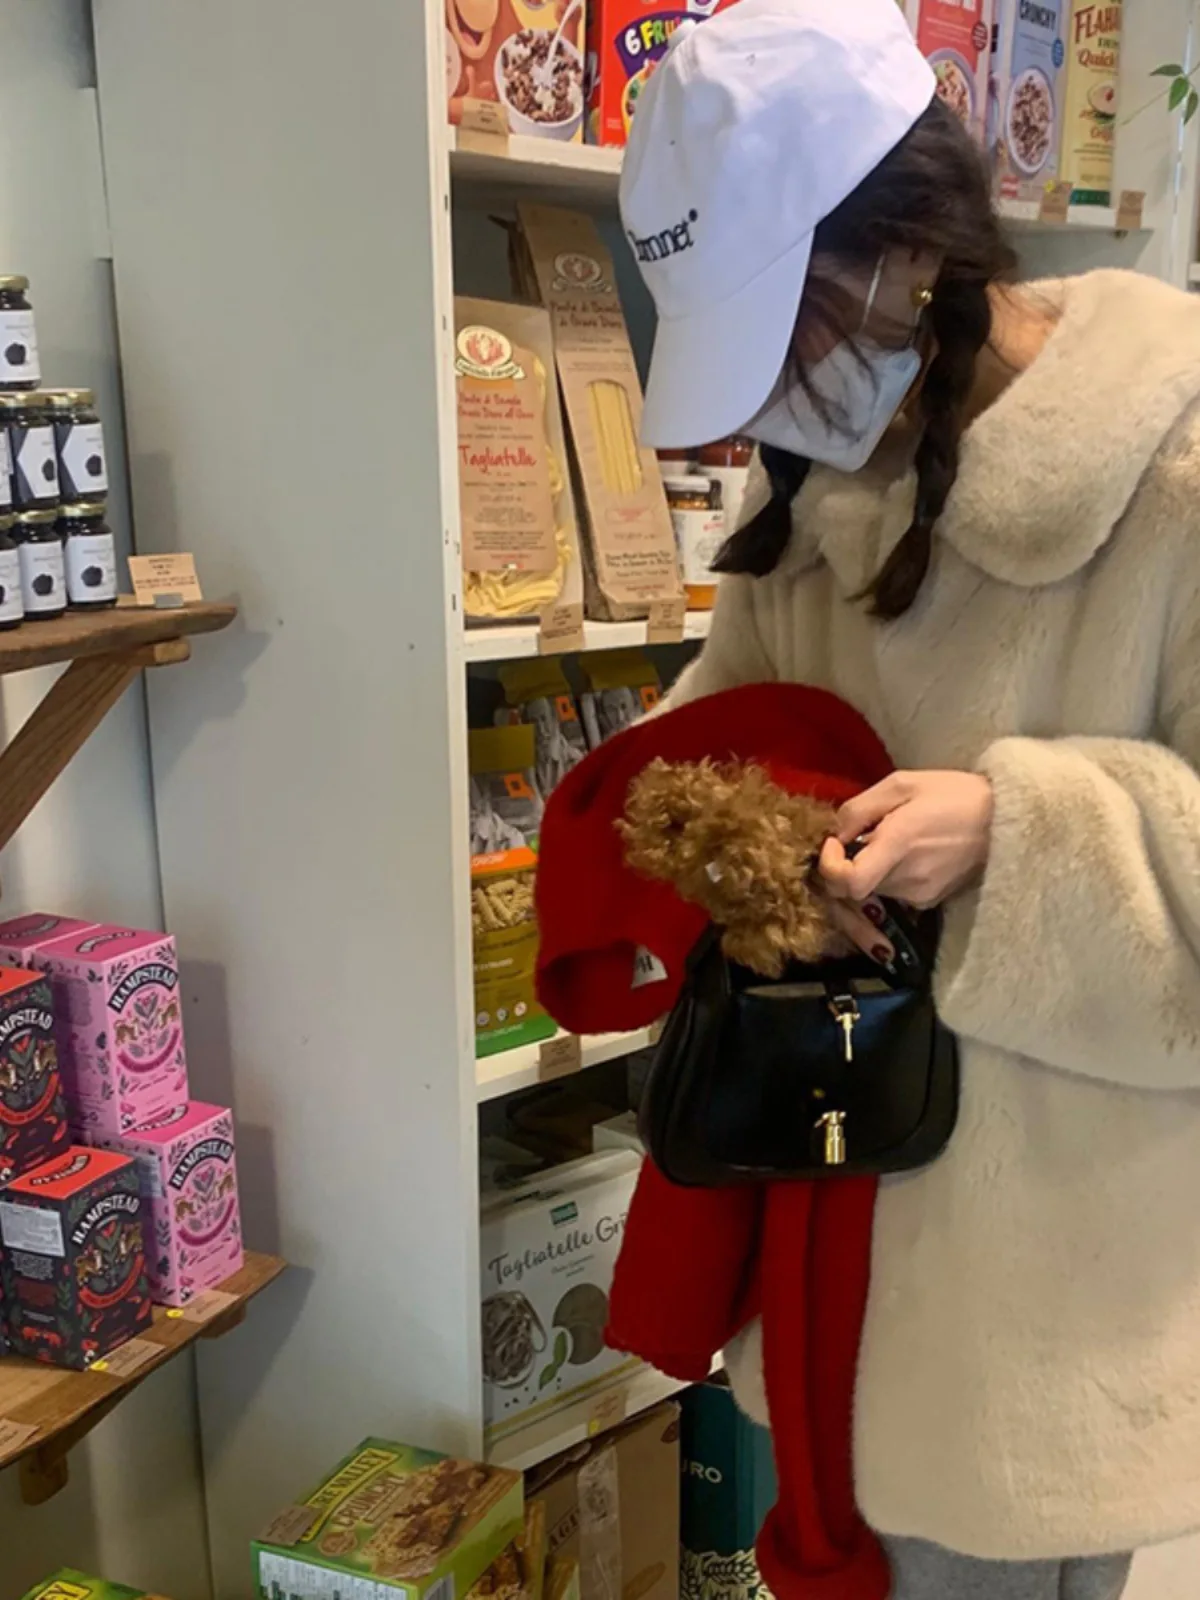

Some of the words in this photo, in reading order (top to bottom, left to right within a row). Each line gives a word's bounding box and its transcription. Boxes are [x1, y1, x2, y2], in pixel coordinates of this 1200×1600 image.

[624, 28, 641, 55] 6
[110, 966, 176, 1010] HAMPSTEAD
[172, 1140, 232, 1187] HAMPSTEAD
[71, 1193, 139, 1245] HAMPSTEAD
[487, 1230, 594, 1284] Tagliatelle
